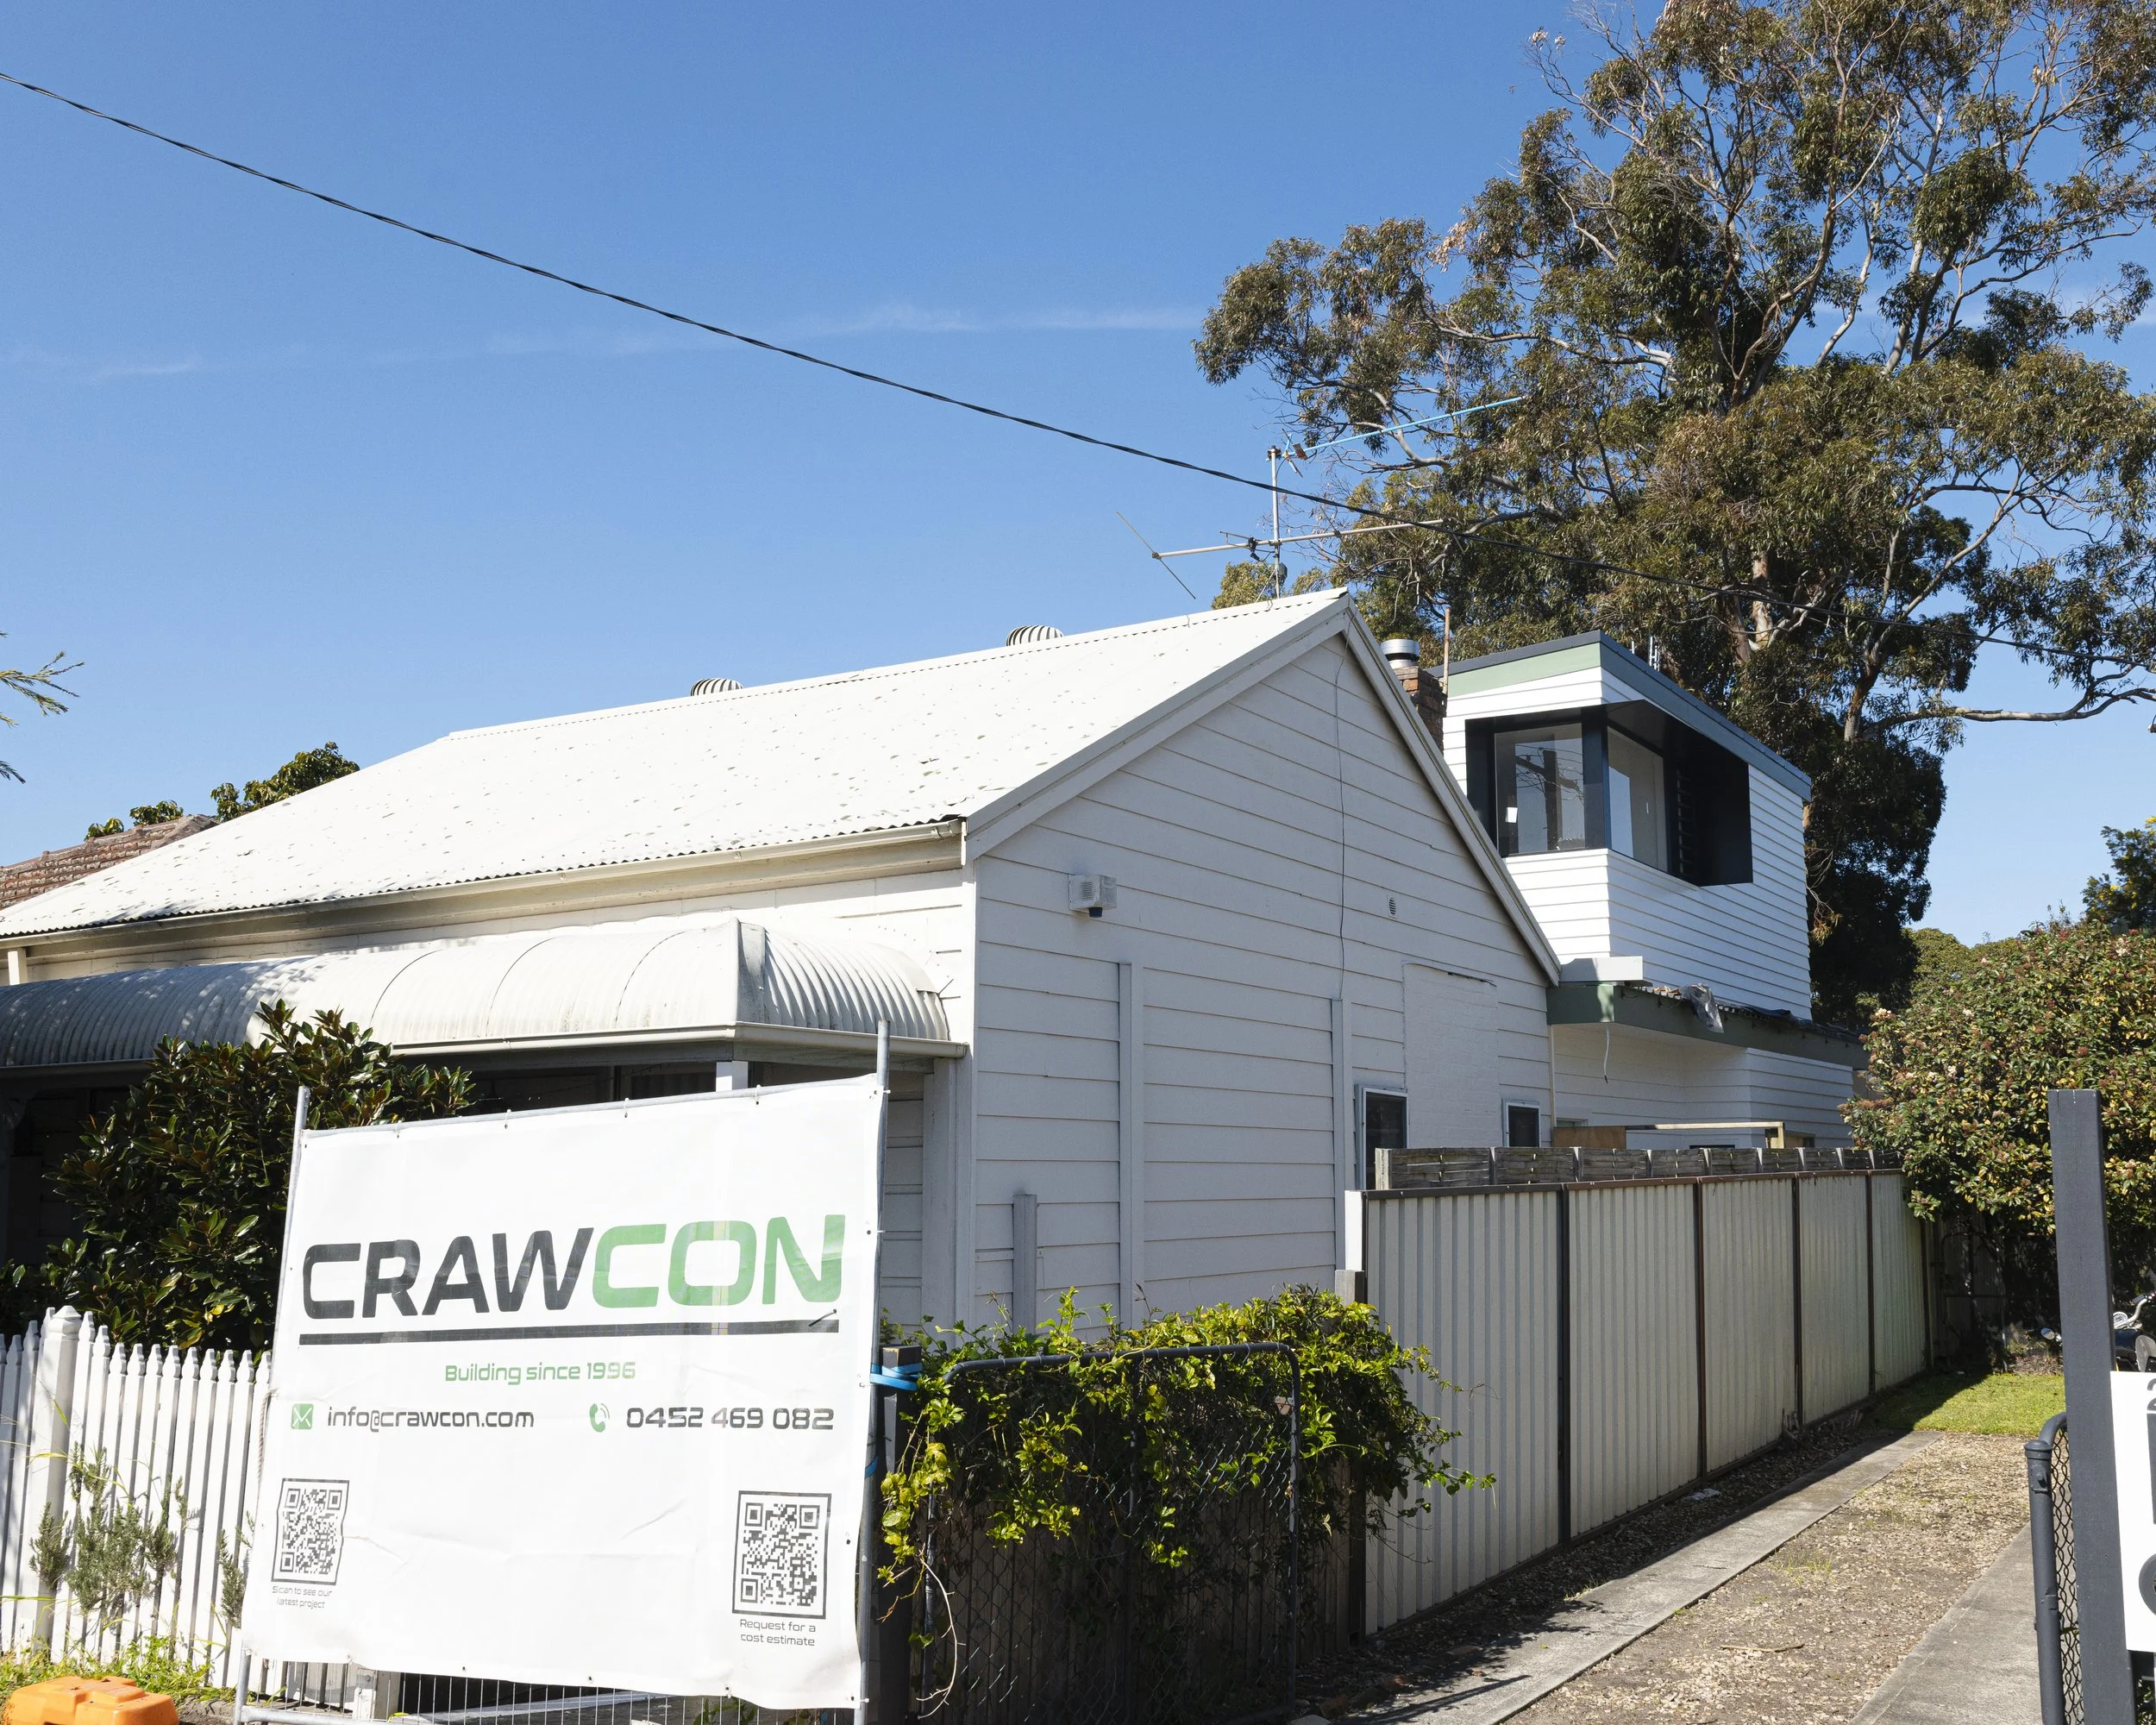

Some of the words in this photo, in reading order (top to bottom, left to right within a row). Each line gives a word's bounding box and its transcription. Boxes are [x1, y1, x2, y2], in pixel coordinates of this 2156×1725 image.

[302, 1214, 846, 1320] CRAWCON
[445, 1362, 522, 1386] Building
[526, 1361, 581, 1381] since
[586, 1361, 636, 1380] 1996
[327, 1406, 535, 1433] info@crawcon.com
[626, 1407, 705, 1428] 0452
[711, 1407, 764, 1429] 469
[772, 1408, 835, 1431] 082
[272, 1585, 293, 1594] Scan
[276, 1596, 298, 1607] latest
[299, 1599, 325, 1610] project
[740, 1618, 786, 1632] Request
[788, 1621, 805, 1632] for
[740, 1634, 764, 1643] cost
[766, 1634, 816, 1647] estimate
